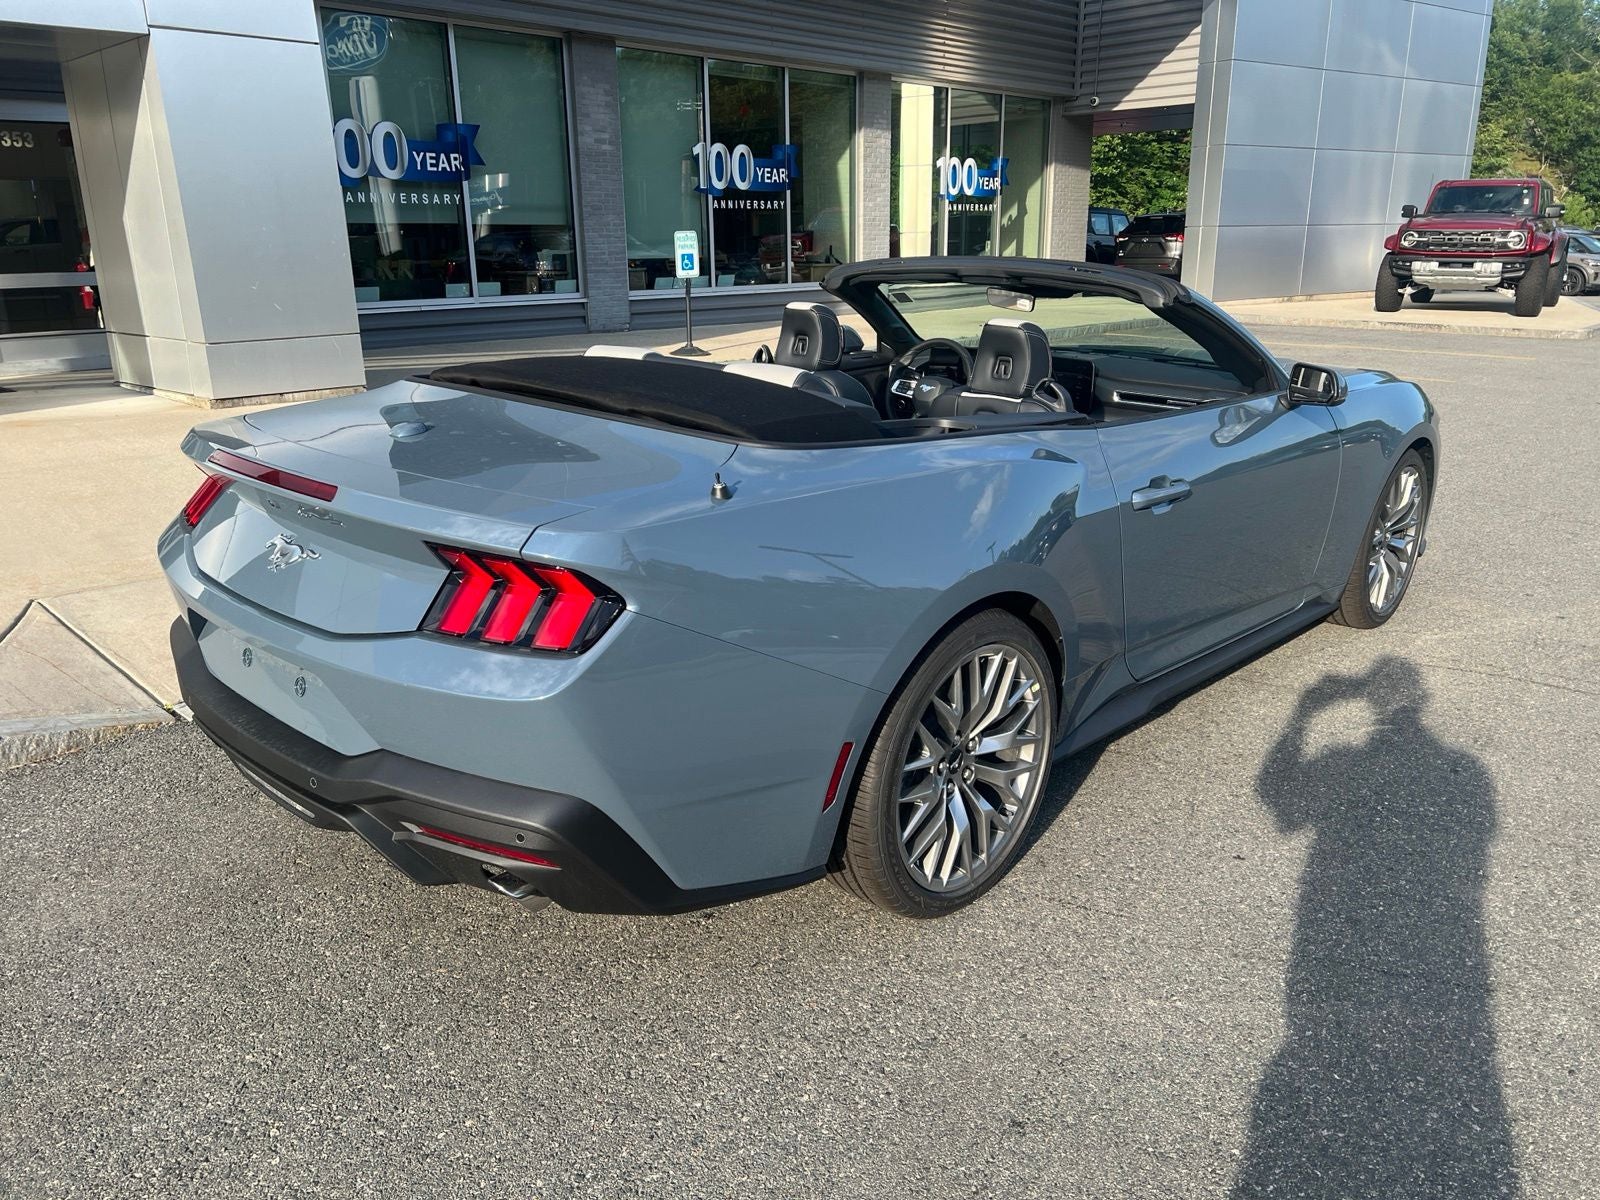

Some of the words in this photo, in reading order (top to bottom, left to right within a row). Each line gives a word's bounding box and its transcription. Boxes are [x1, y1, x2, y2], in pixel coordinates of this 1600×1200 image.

[0, 130, 34, 148] 353
[334, 118, 409, 180] 00
[692, 142, 754, 190] 100
[936, 156, 978, 196] 100
[345, 191, 461, 205] ANNIVERSARY
[713, 199, 785, 210] ANNIVERSARY
[948, 203, 998, 212] ANNIVERSARY
